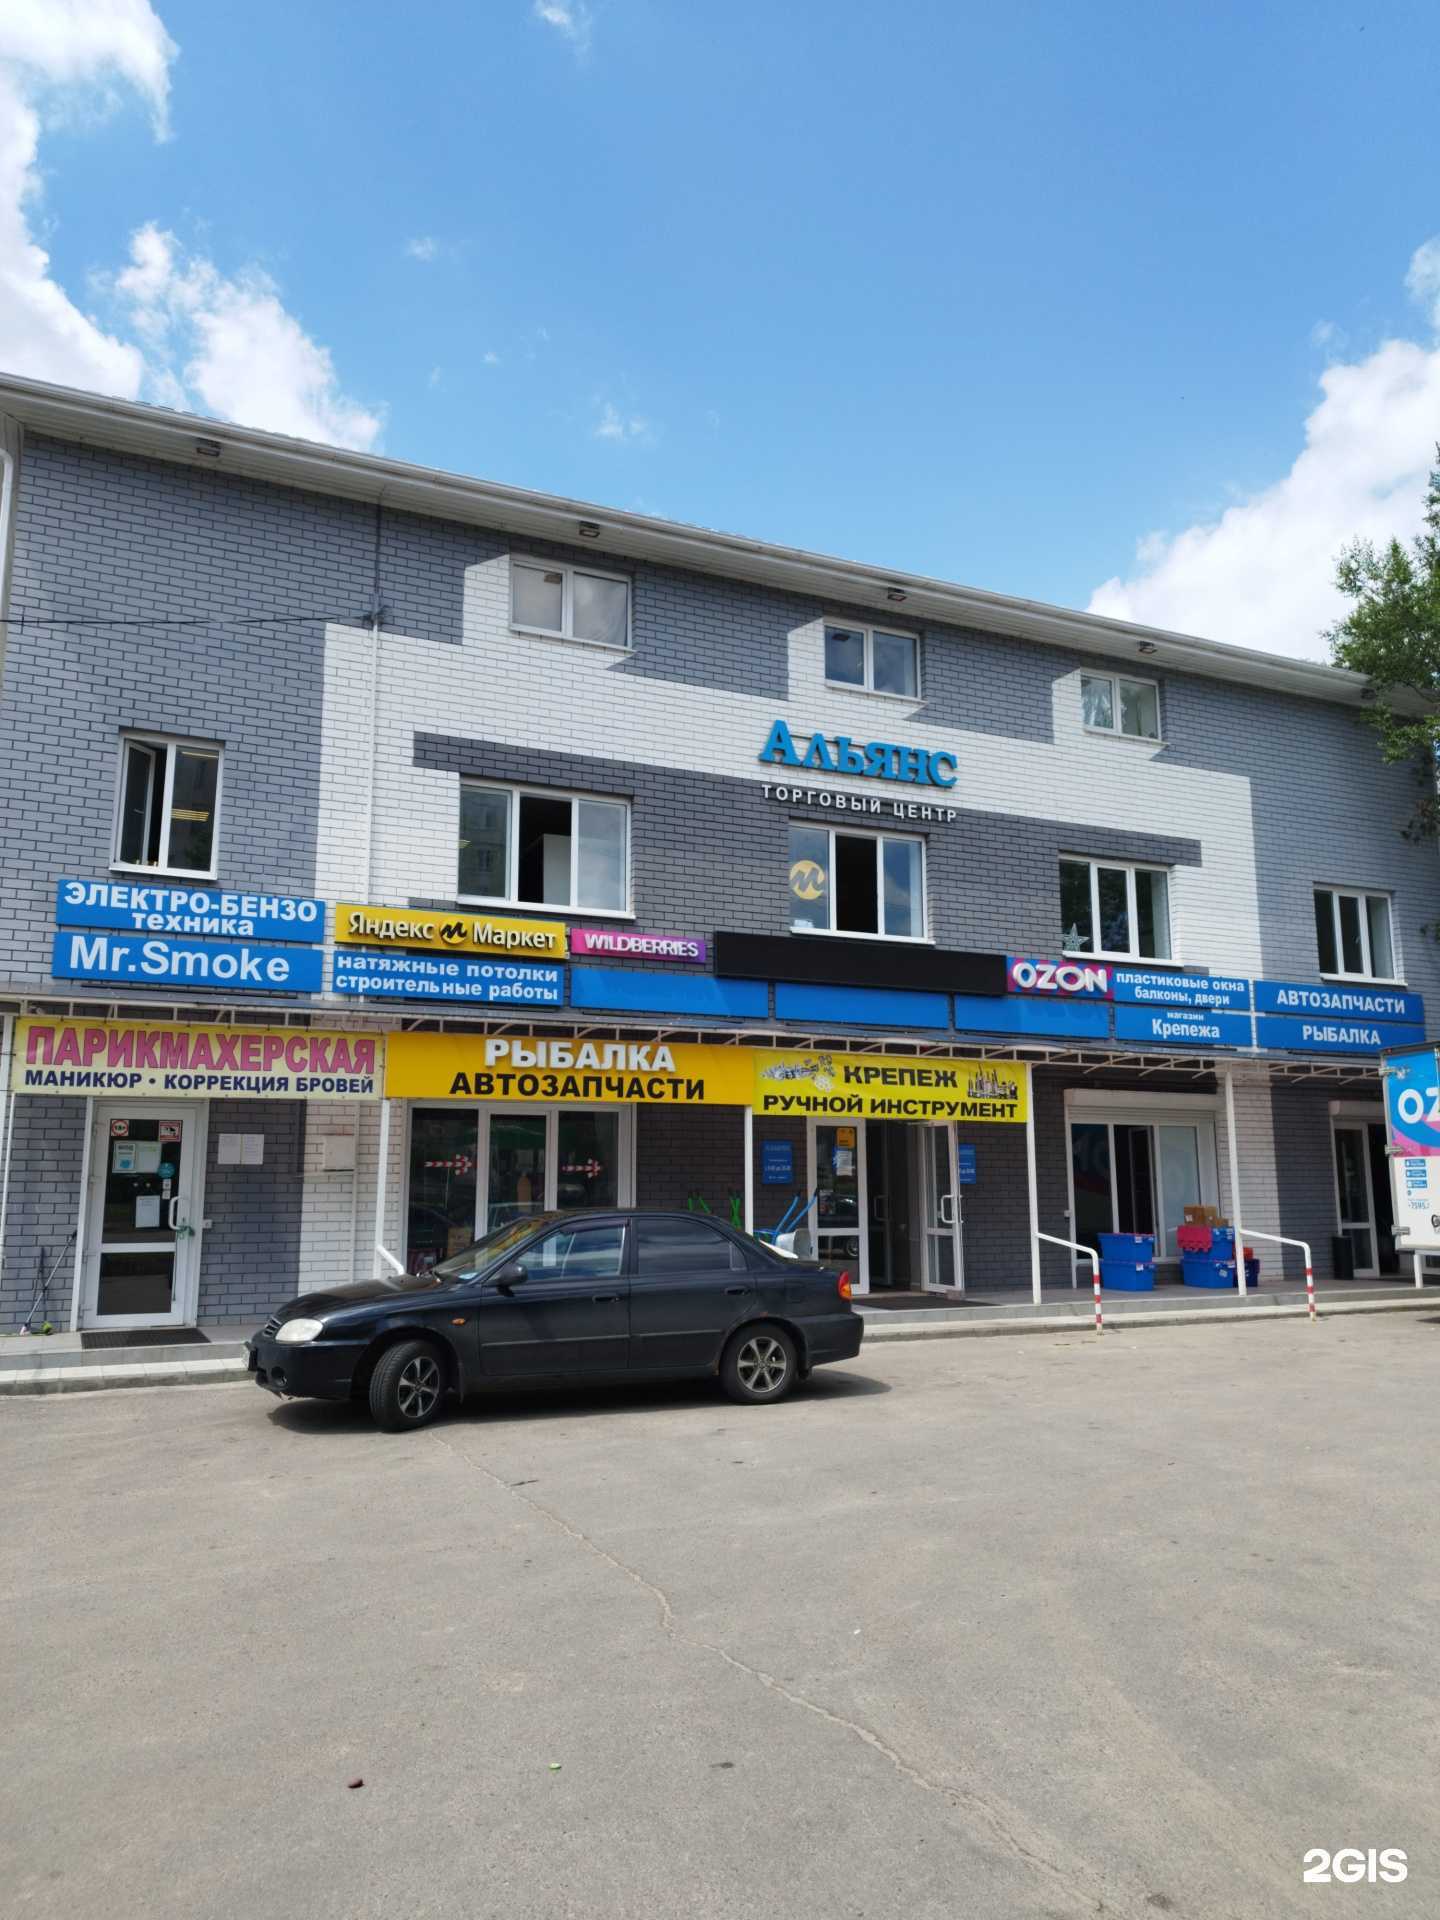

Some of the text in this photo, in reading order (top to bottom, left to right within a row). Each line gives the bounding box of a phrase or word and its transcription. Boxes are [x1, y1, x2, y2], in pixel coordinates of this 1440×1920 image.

[762, 784, 957, 822] ТОРГОВЫЙ ЦЕНТР
[65, 882, 317, 922] ЭЛЕКТРО-БЕНЗО
[132, 912, 254, 936] техника
[348, 911, 556, 949] Яндекс Маркет
[585, 933, 699, 958] WILDBERRIES
[70, 935, 290, 982] Mr.Smoke
[337, 955, 558, 983] натяжные потолки
[336, 975, 558, 1001] строительные работы
[1012, 962, 1108, 994] OZON
[1116, 972, 1245, 992] пластиковые окна
[1134, 986, 1230, 1007] балконы, двери
[1277, 989, 1405, 1014] АВТОЗАПЧАСТИ
[1152, 1018, 1220, 1039] Крепежа
[1302, 1025, 1381, 1045] РЫБАЛКА
[25, 1026, 375, 1074] ПАРИКМАХЕРСКАЯ
[484, 1038, 676, 1072] РЫБАЛКА
[24, 1069, 374, 1094] МАНИКЮР КОРРЕКЦИЯ БРОВЕЙ
[449, 1072, 705, 1100] АВТОЗАПЧАСТИ
[843, 1065, 957, 1088] КРЕПЕЖ
[763, 1094, 1018, 1118] РУЧНОЙ ИНСТРУМЕНТ
